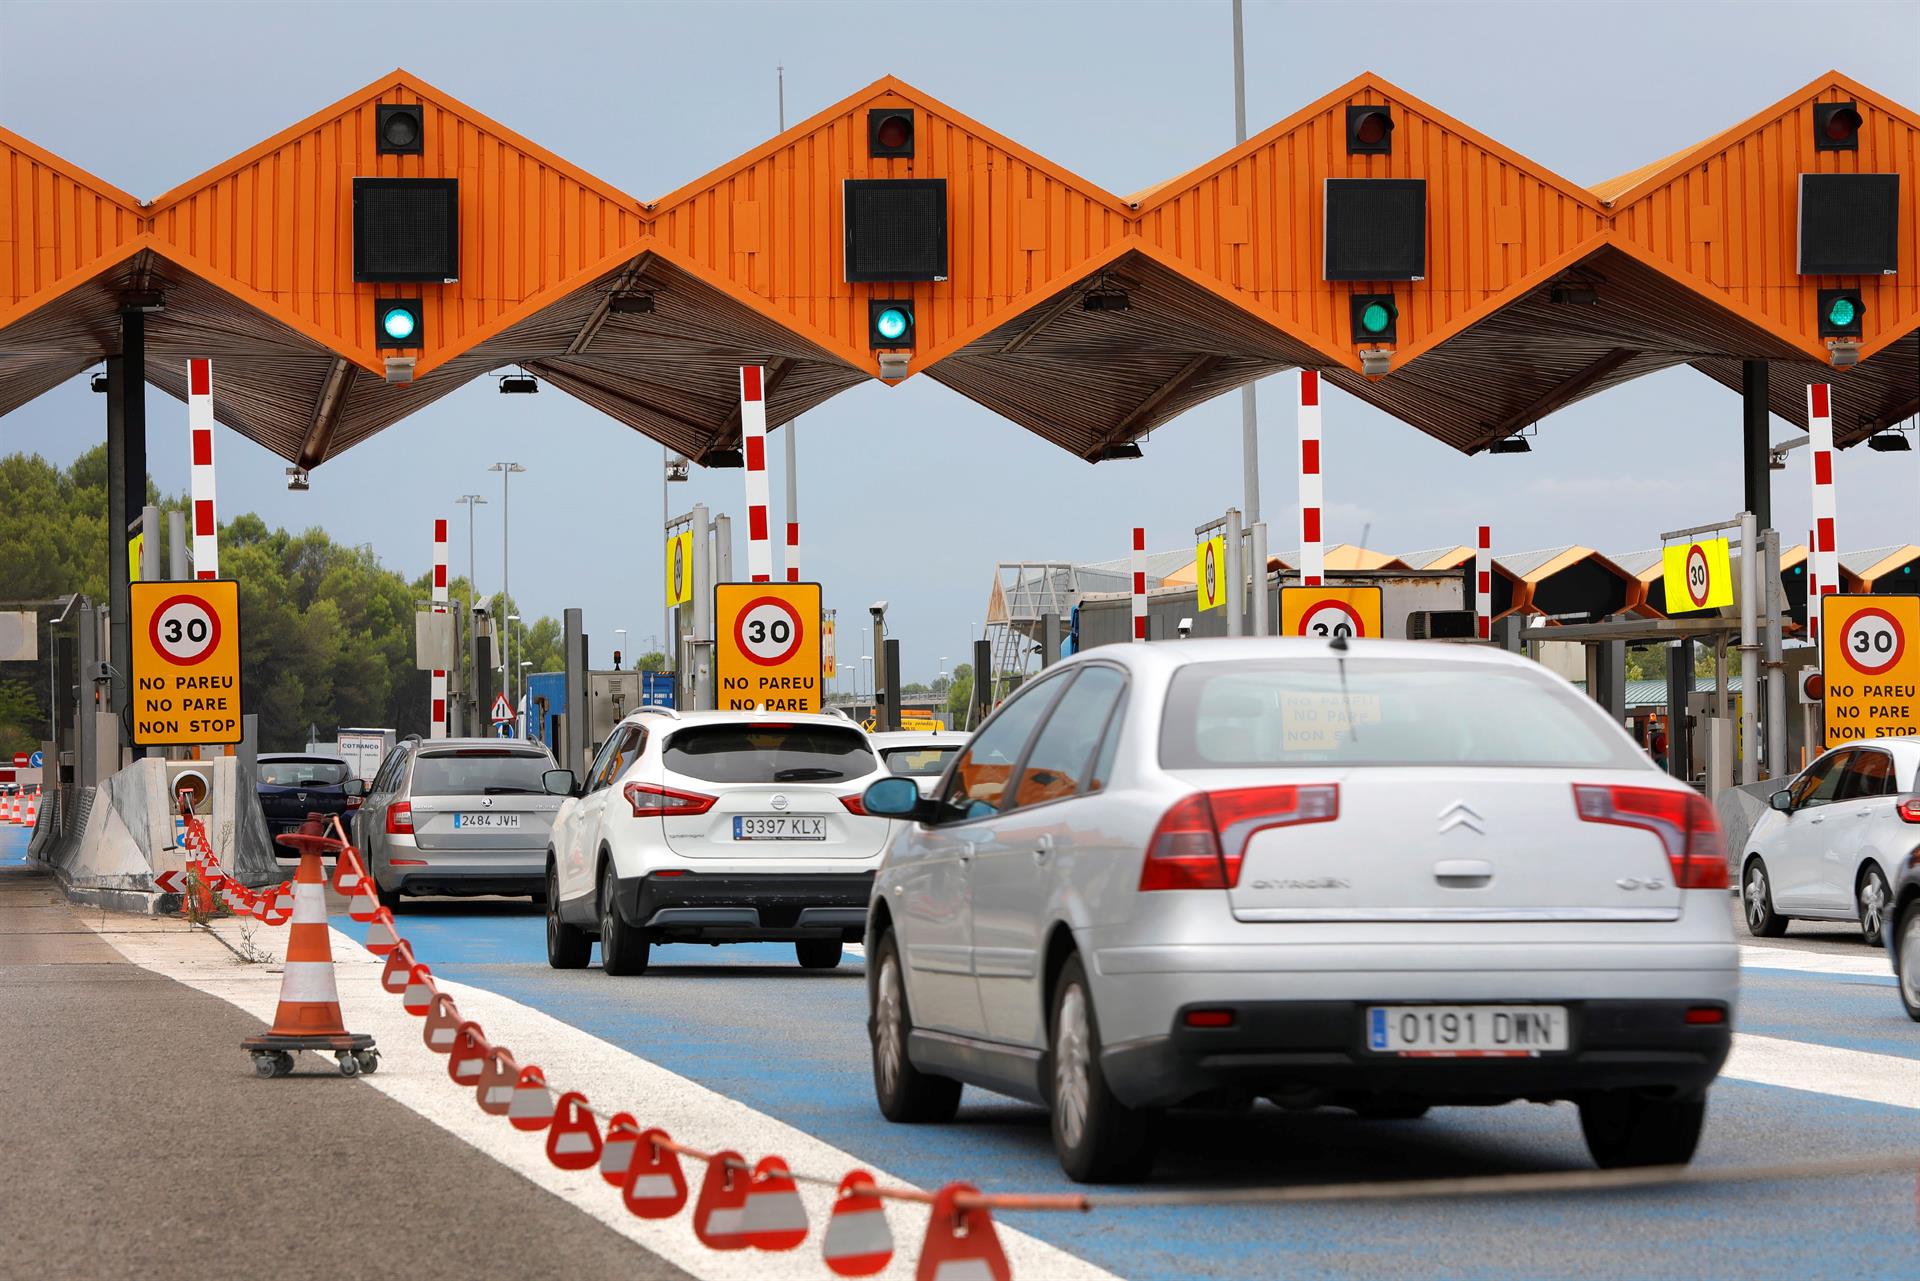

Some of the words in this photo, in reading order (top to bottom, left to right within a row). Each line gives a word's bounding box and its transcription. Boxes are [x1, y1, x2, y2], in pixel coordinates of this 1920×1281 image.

[1690, 565, 1704, 586] 30
[165, 619, 207, 643] 30
[748, 620, 790, 643] 30
[1313, 622, 1352, 637] 30
[1853, 630, 1892, 653] 30
[140, 677, 165, 690] NO
[176, 676, 233, 689] PAREU
[724, 677, 749, 689] NO
[759, 677, 814, 689] PAREU
[1830, 685, 1854, 697] NO
[1864, 685, 1915, 697] PAREU
[147, 698, 172, 712] NO
[183, 698, 227, 711] PARE
[730, 698, 755, 710] NO
[765, 698, 808, 711] PARE
[1837, 705, 1860, 718] NO
[1869, 705, 1910, 718] PARE
[140, 721, 178, 734] NON
[190, 719, 235, 732] STOP
[1830, 726, 1865, 739] NON
[1876, 726, 1917, 738] STOP
[462, 815, 491, 827] 2484
[496, 815, 518, 827] JVH
[745, 819, 785, 834] 9397
[791, 819, 821, 834] KLX
[1400, 1012, 1476, 1044] 0191
